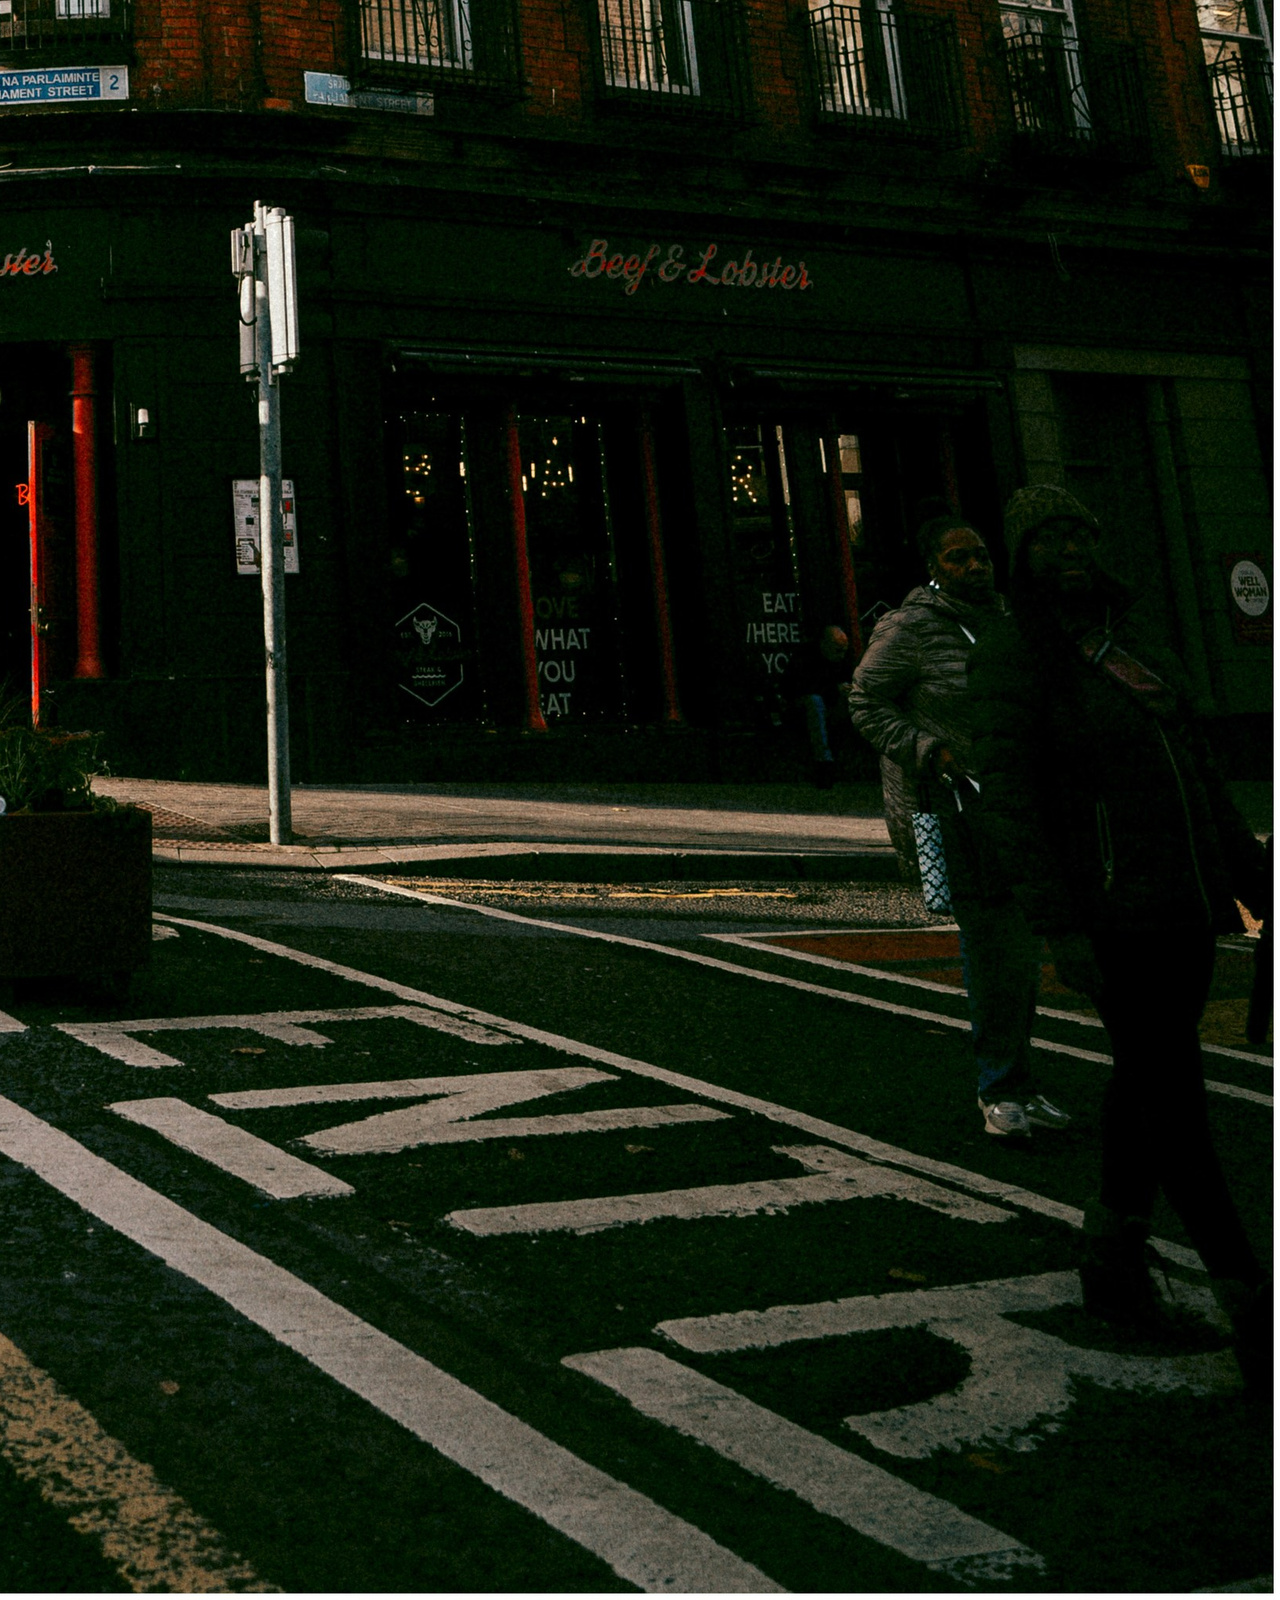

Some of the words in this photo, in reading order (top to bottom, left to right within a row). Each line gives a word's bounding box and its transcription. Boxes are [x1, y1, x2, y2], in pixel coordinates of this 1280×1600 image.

[2, 75, 19, 87] NA
[22, 72, 99, 85] PARLAIMINTE
[109, 75, 119, 90] 2
[48, 85, 94, 97] STREET
[570, 239, 661, 296] Beef
[658, 244, 687, 282] &
[687, 244, 813, 290] Lobster
[1238, 576, 1260, 586] WELL
[762, 593, 796, 613] EAT
[1234, 587, 1267, 599] WOMAN
[537, 596, 579, 619] OVE
[761, 652, 793, 674] YO
[50, 1003, 1270, 1480] ENTR
